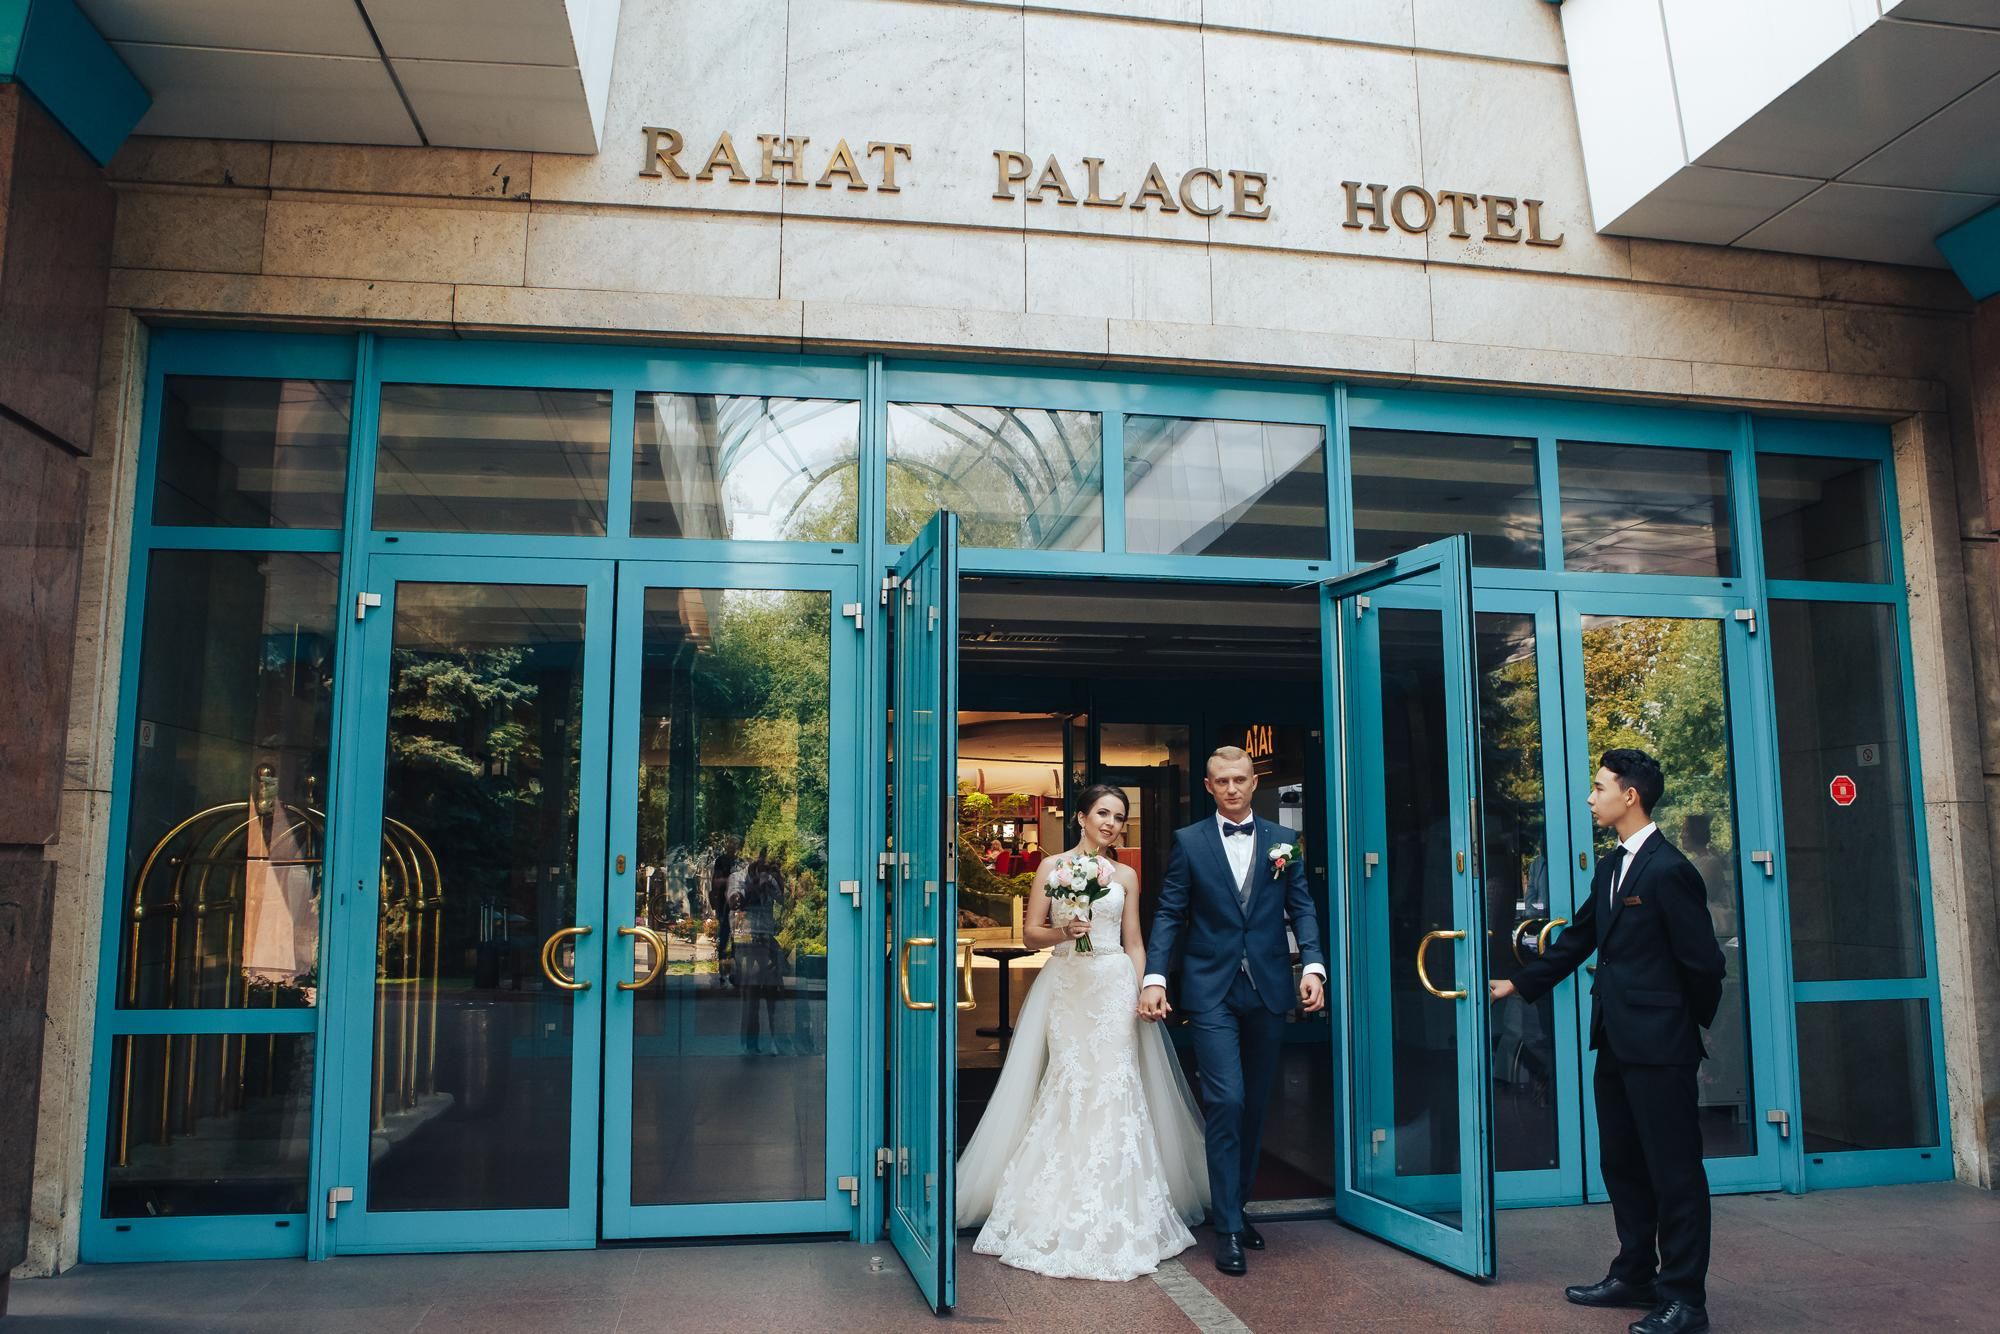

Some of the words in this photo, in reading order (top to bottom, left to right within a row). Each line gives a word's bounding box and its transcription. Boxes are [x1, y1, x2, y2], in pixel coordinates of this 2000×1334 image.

[638, 125, 912, 193] RAHAT
[992, 149, 1271, 220] PALACE
[1341, 180, 1565, 248] HOTEL
